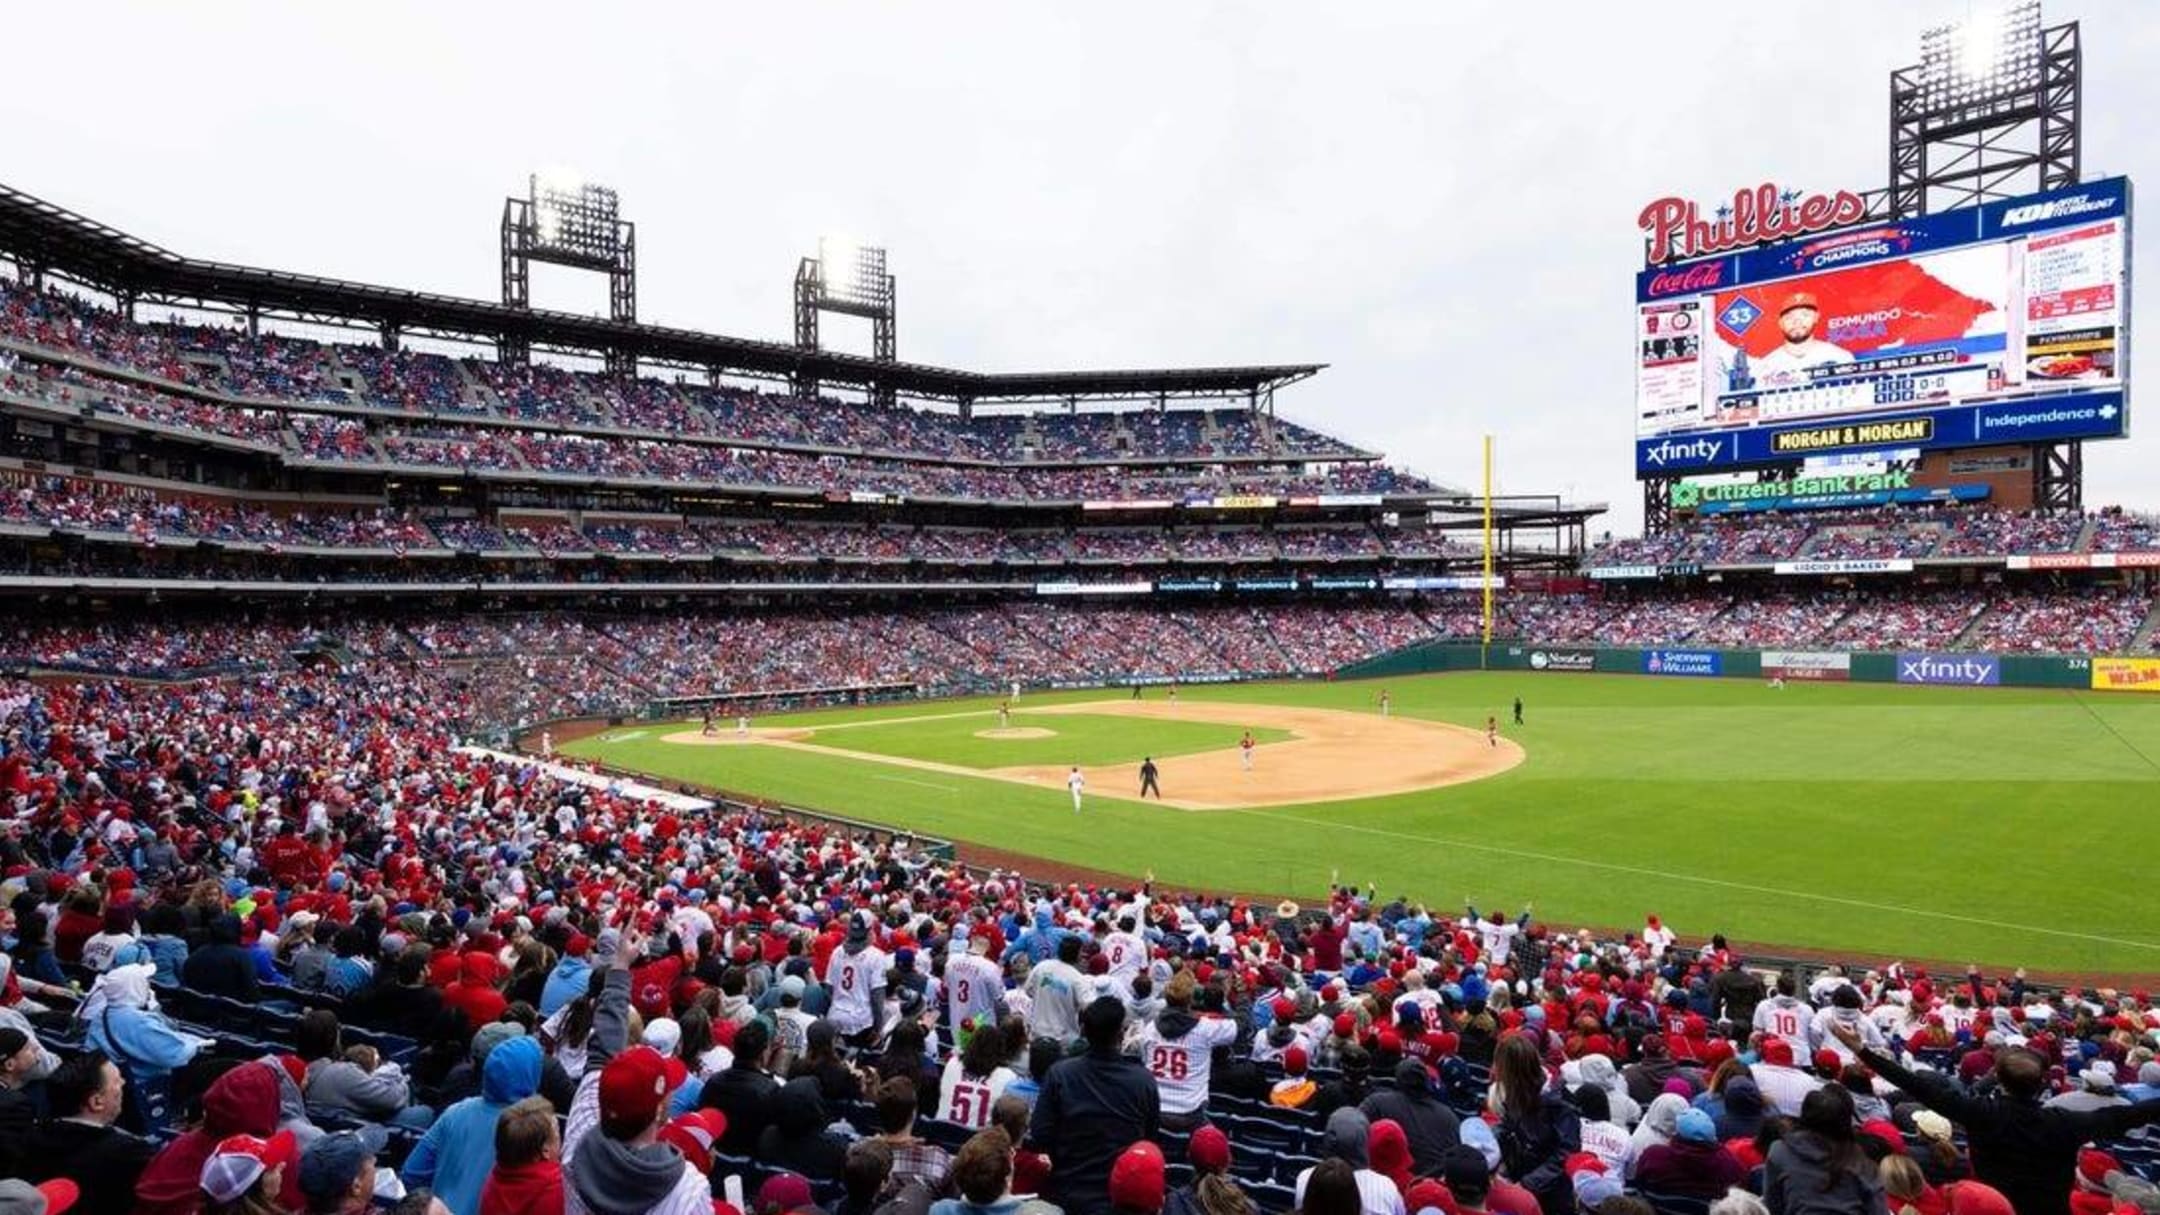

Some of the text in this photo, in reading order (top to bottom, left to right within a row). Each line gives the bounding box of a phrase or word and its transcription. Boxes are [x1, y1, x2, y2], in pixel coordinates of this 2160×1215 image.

[1638, 181, 1865, 265] Phillies
[1812, 243, 1890, 267] CHAMPIONS
[1727, 308, 1754, 326] 33
[1828, 307, 1901, 329] EDMUNDO
[1985, 406, 2096, 428] Independence
[1779, 421, 1925, 450] MORGAN & MORGAN
[1646, 439, 1722, 466] xfinity
[1702, 480, 1788, 501] Citizens
[1792, 475, 1850, 496] Bank
[1854, 469, 1911, 493] Park
[1674, 565, 1700, 576] LIFE
[1844, 561, 1890, 571] BAKERY
[2032, 557, 2090, 567] TOYOTA
[1549, 652, 1594, 664] NovaCare
[1663, 652, 1713, 664] SHERWIN
[1903, 656, 1993, 683] xfinity
[2067, 659, 2089, 671] 374
[1111, 946, 1123, 965] 8
[841, 966, 855, 991] 3
[957, 979, 970, 1004] 3
[1773, 1013, 1798, 1036] 10
[1152, 1045, 1188, 1082] 26
[949, 1084, 992, 1127] 51
